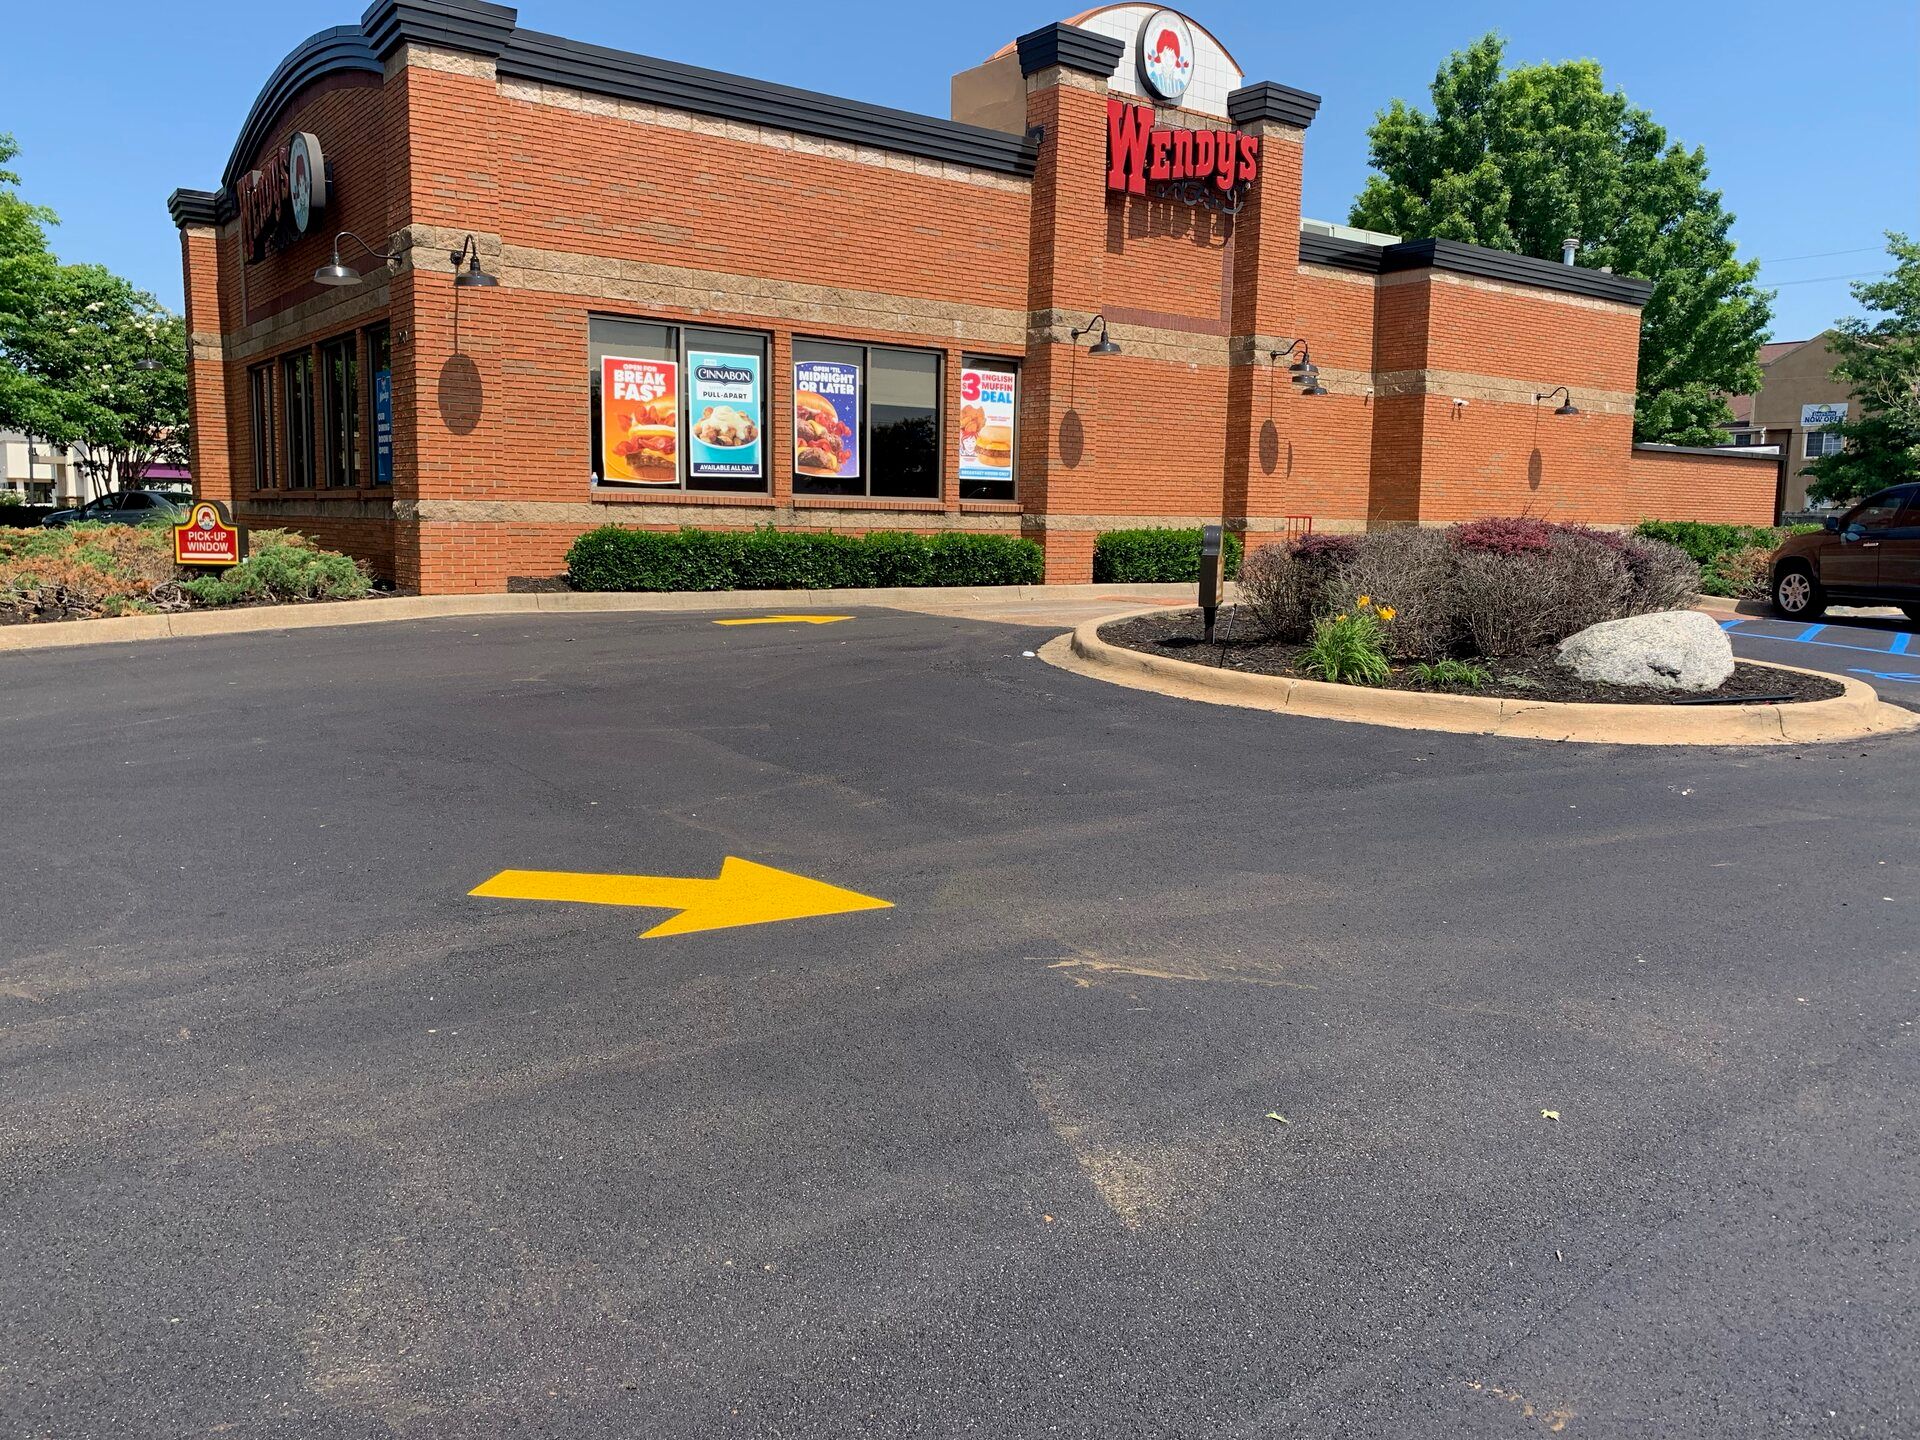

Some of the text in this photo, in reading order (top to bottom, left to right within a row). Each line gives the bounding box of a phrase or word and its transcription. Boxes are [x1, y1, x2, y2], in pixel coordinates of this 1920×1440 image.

[1106, 98, 1259, 197] Wendy's
[698, 367, 751, 381] CINNABON
[812, 365, 830, 373] OPEN
[614, 369, 666, 386] BREAK
[799, 370, 855, 384] MIDNIGHT
[981, 373, 1013, 383] ENGLISH
[614, 382, 666, 402] FAST
[799, 381, 855, 395] OR LATER
[981, 382, 1013, 392] MUFFIN
[703, 391, 747, 400] PULL-APART
[981, 390, 1013, 404] DEAL
[187, 531, 227, 541] PICK-UP
[187, 541, 229, 552] WINDOW
